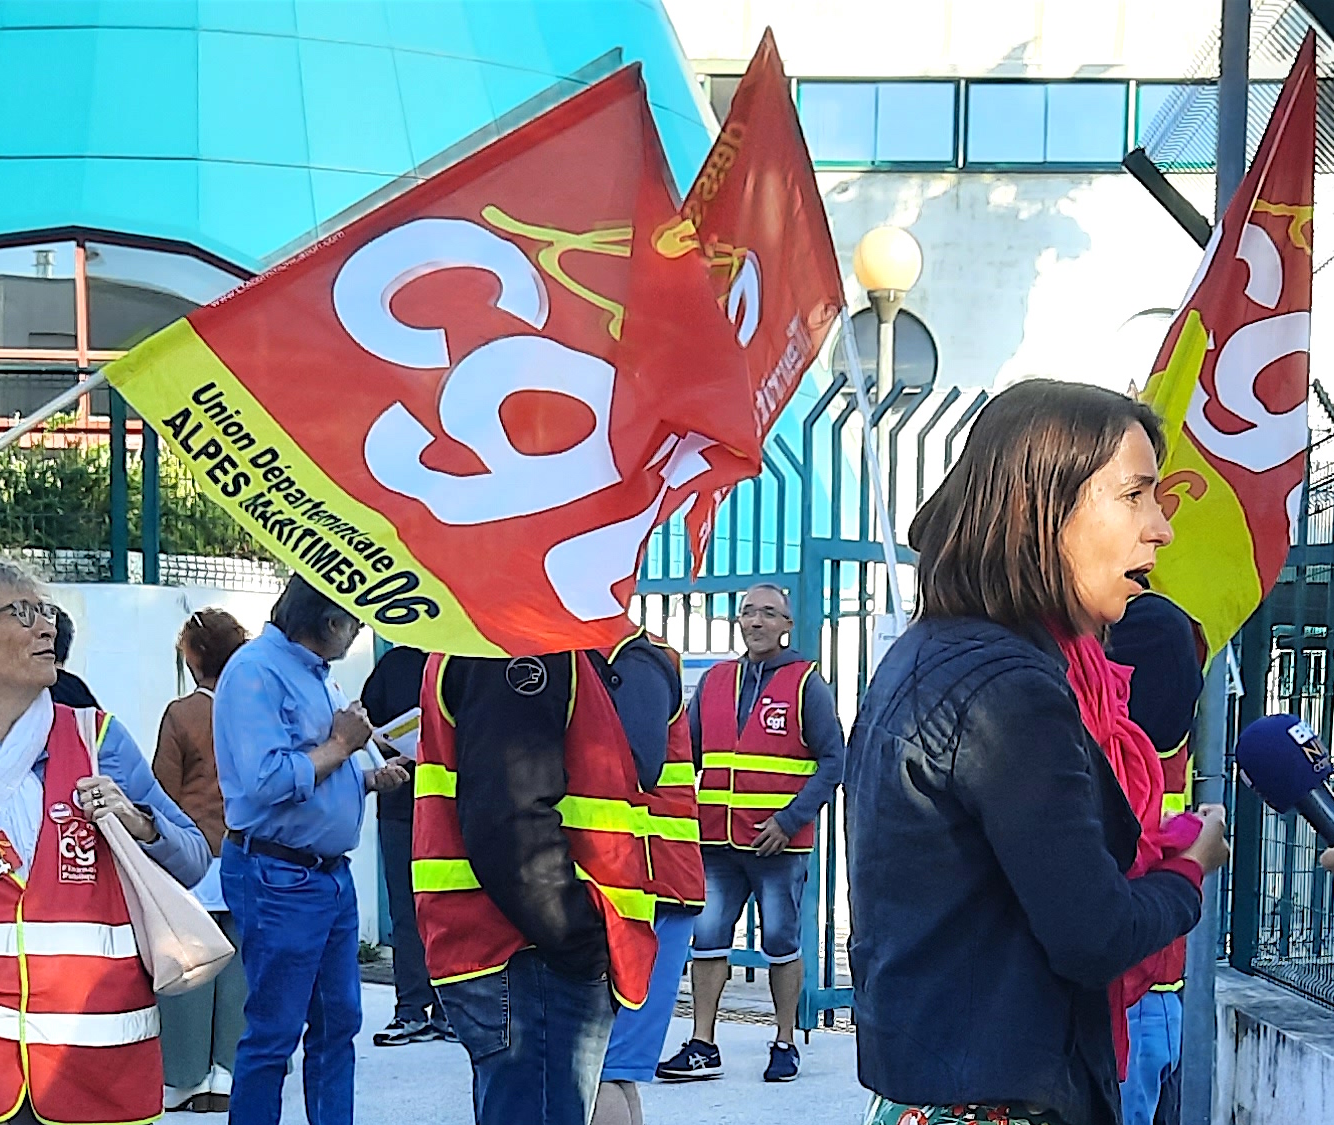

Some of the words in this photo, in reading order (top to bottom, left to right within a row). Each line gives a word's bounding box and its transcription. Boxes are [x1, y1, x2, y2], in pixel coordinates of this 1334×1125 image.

[162, 407, 251, 498] ALPES
[238, 492, 367, 595] MARITIMES
[354, 570, 441, 625] 06
[192, 381, 257, 451] Union
[249, 446, 395, 573] Départementale
[767, 716, 785, 729] cgt
